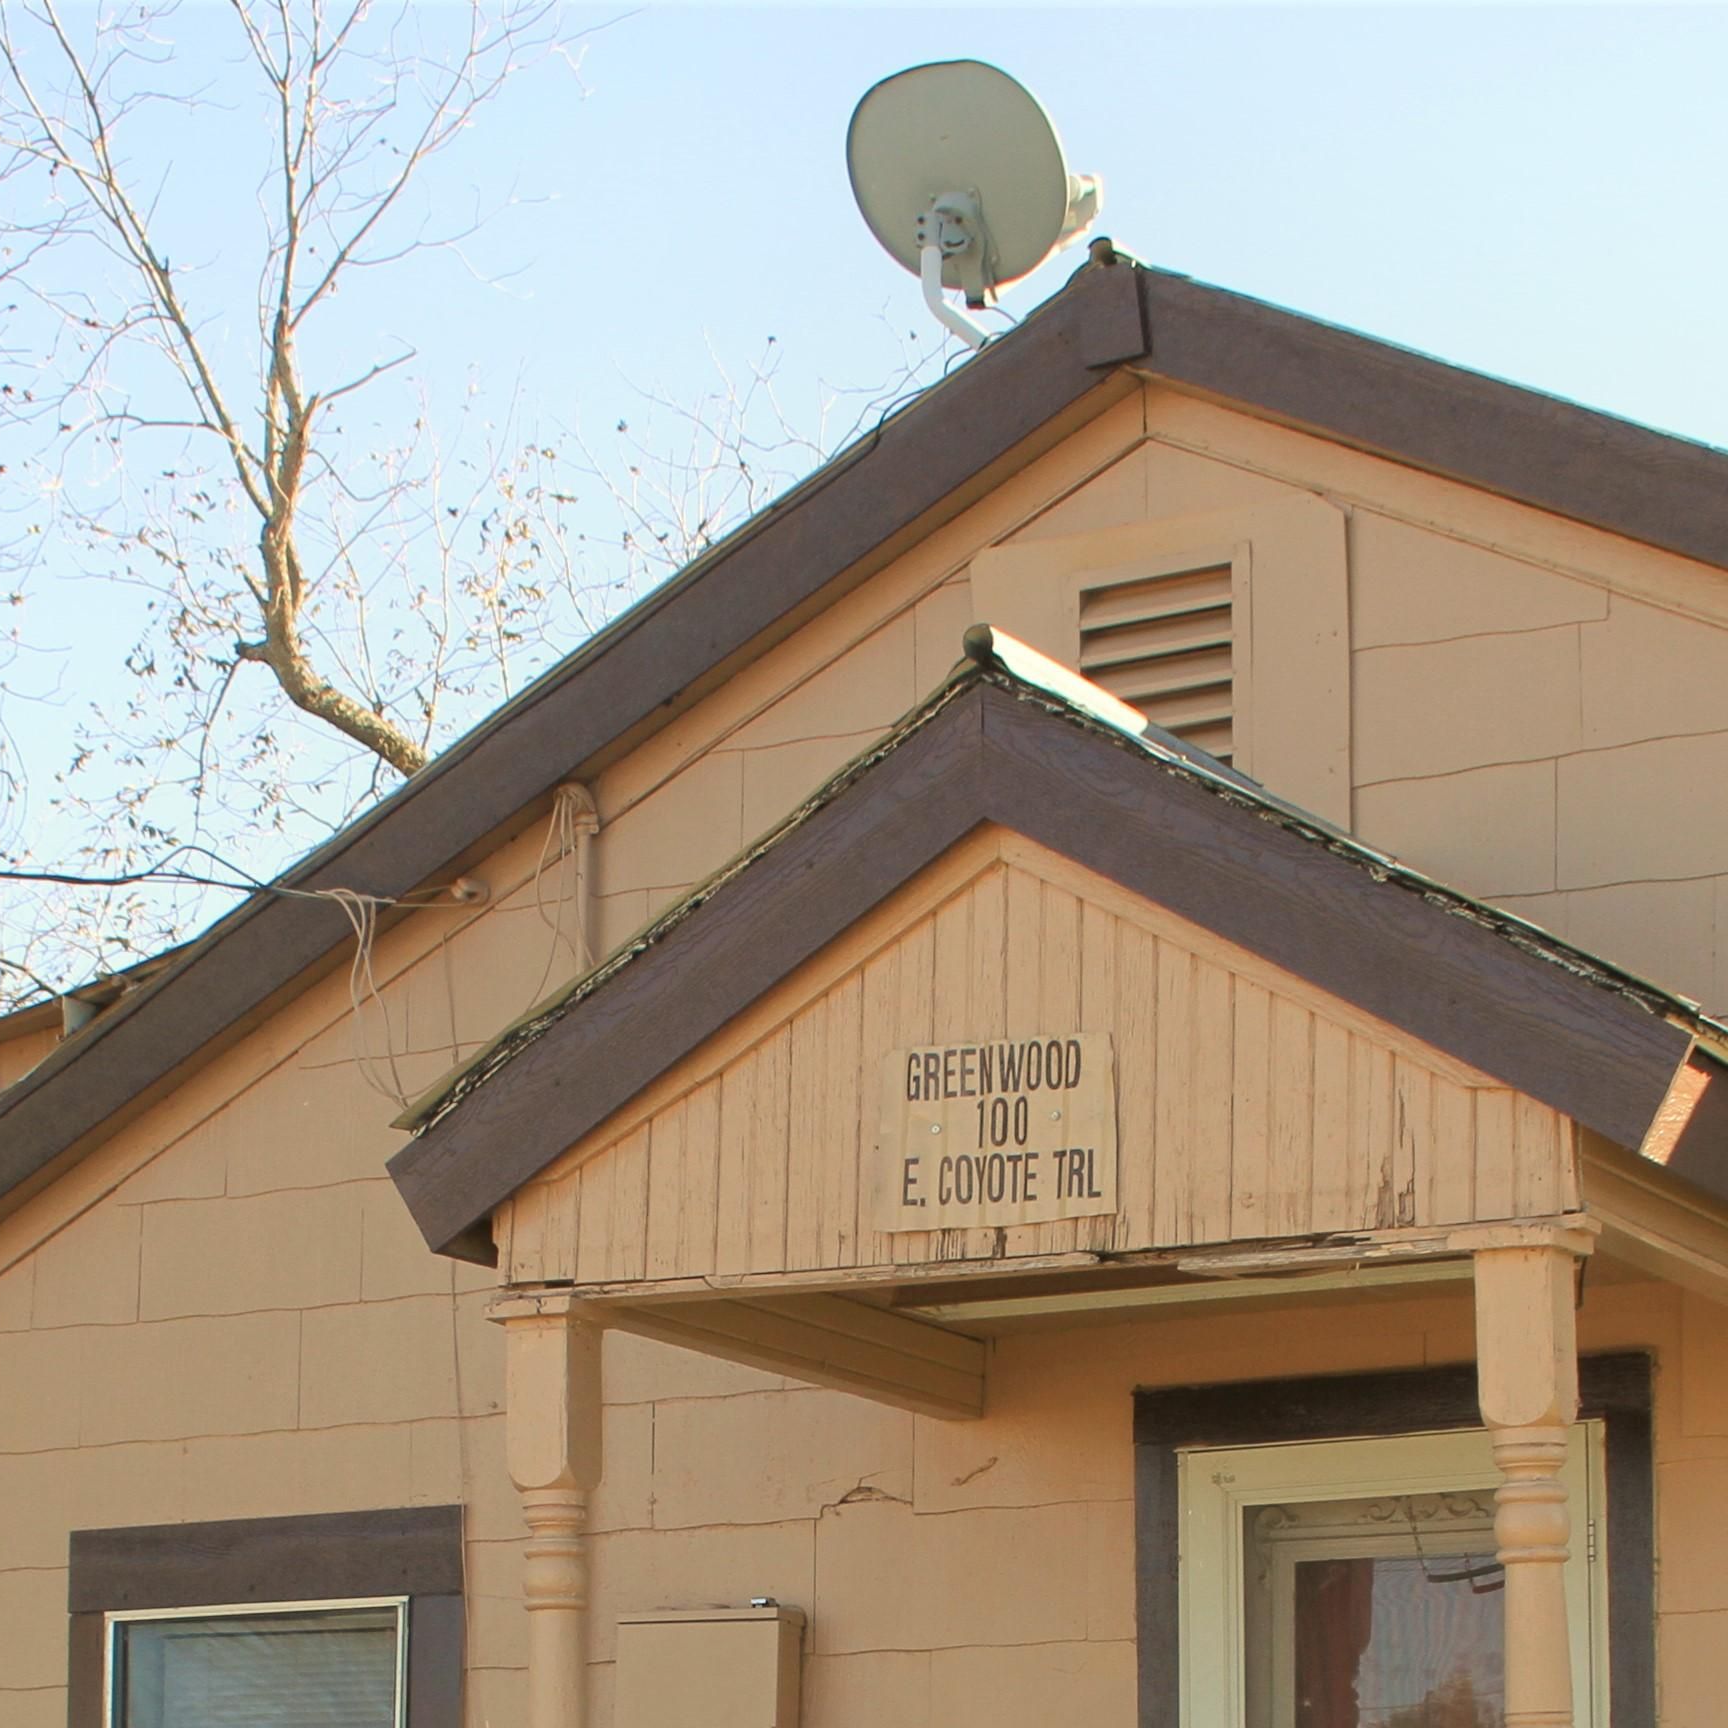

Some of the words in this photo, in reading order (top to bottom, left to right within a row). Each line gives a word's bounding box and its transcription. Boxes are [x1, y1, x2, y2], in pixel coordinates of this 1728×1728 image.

[906, 1039, 1082, 1101] GREENWOOD
[977, 1096, 1029, 1148] 100
[902, 1157, 926, 1207] E.
[938, 1152, 1039, 1206] COYOTE
[1053, 1148, 1102, 1199] TRL
